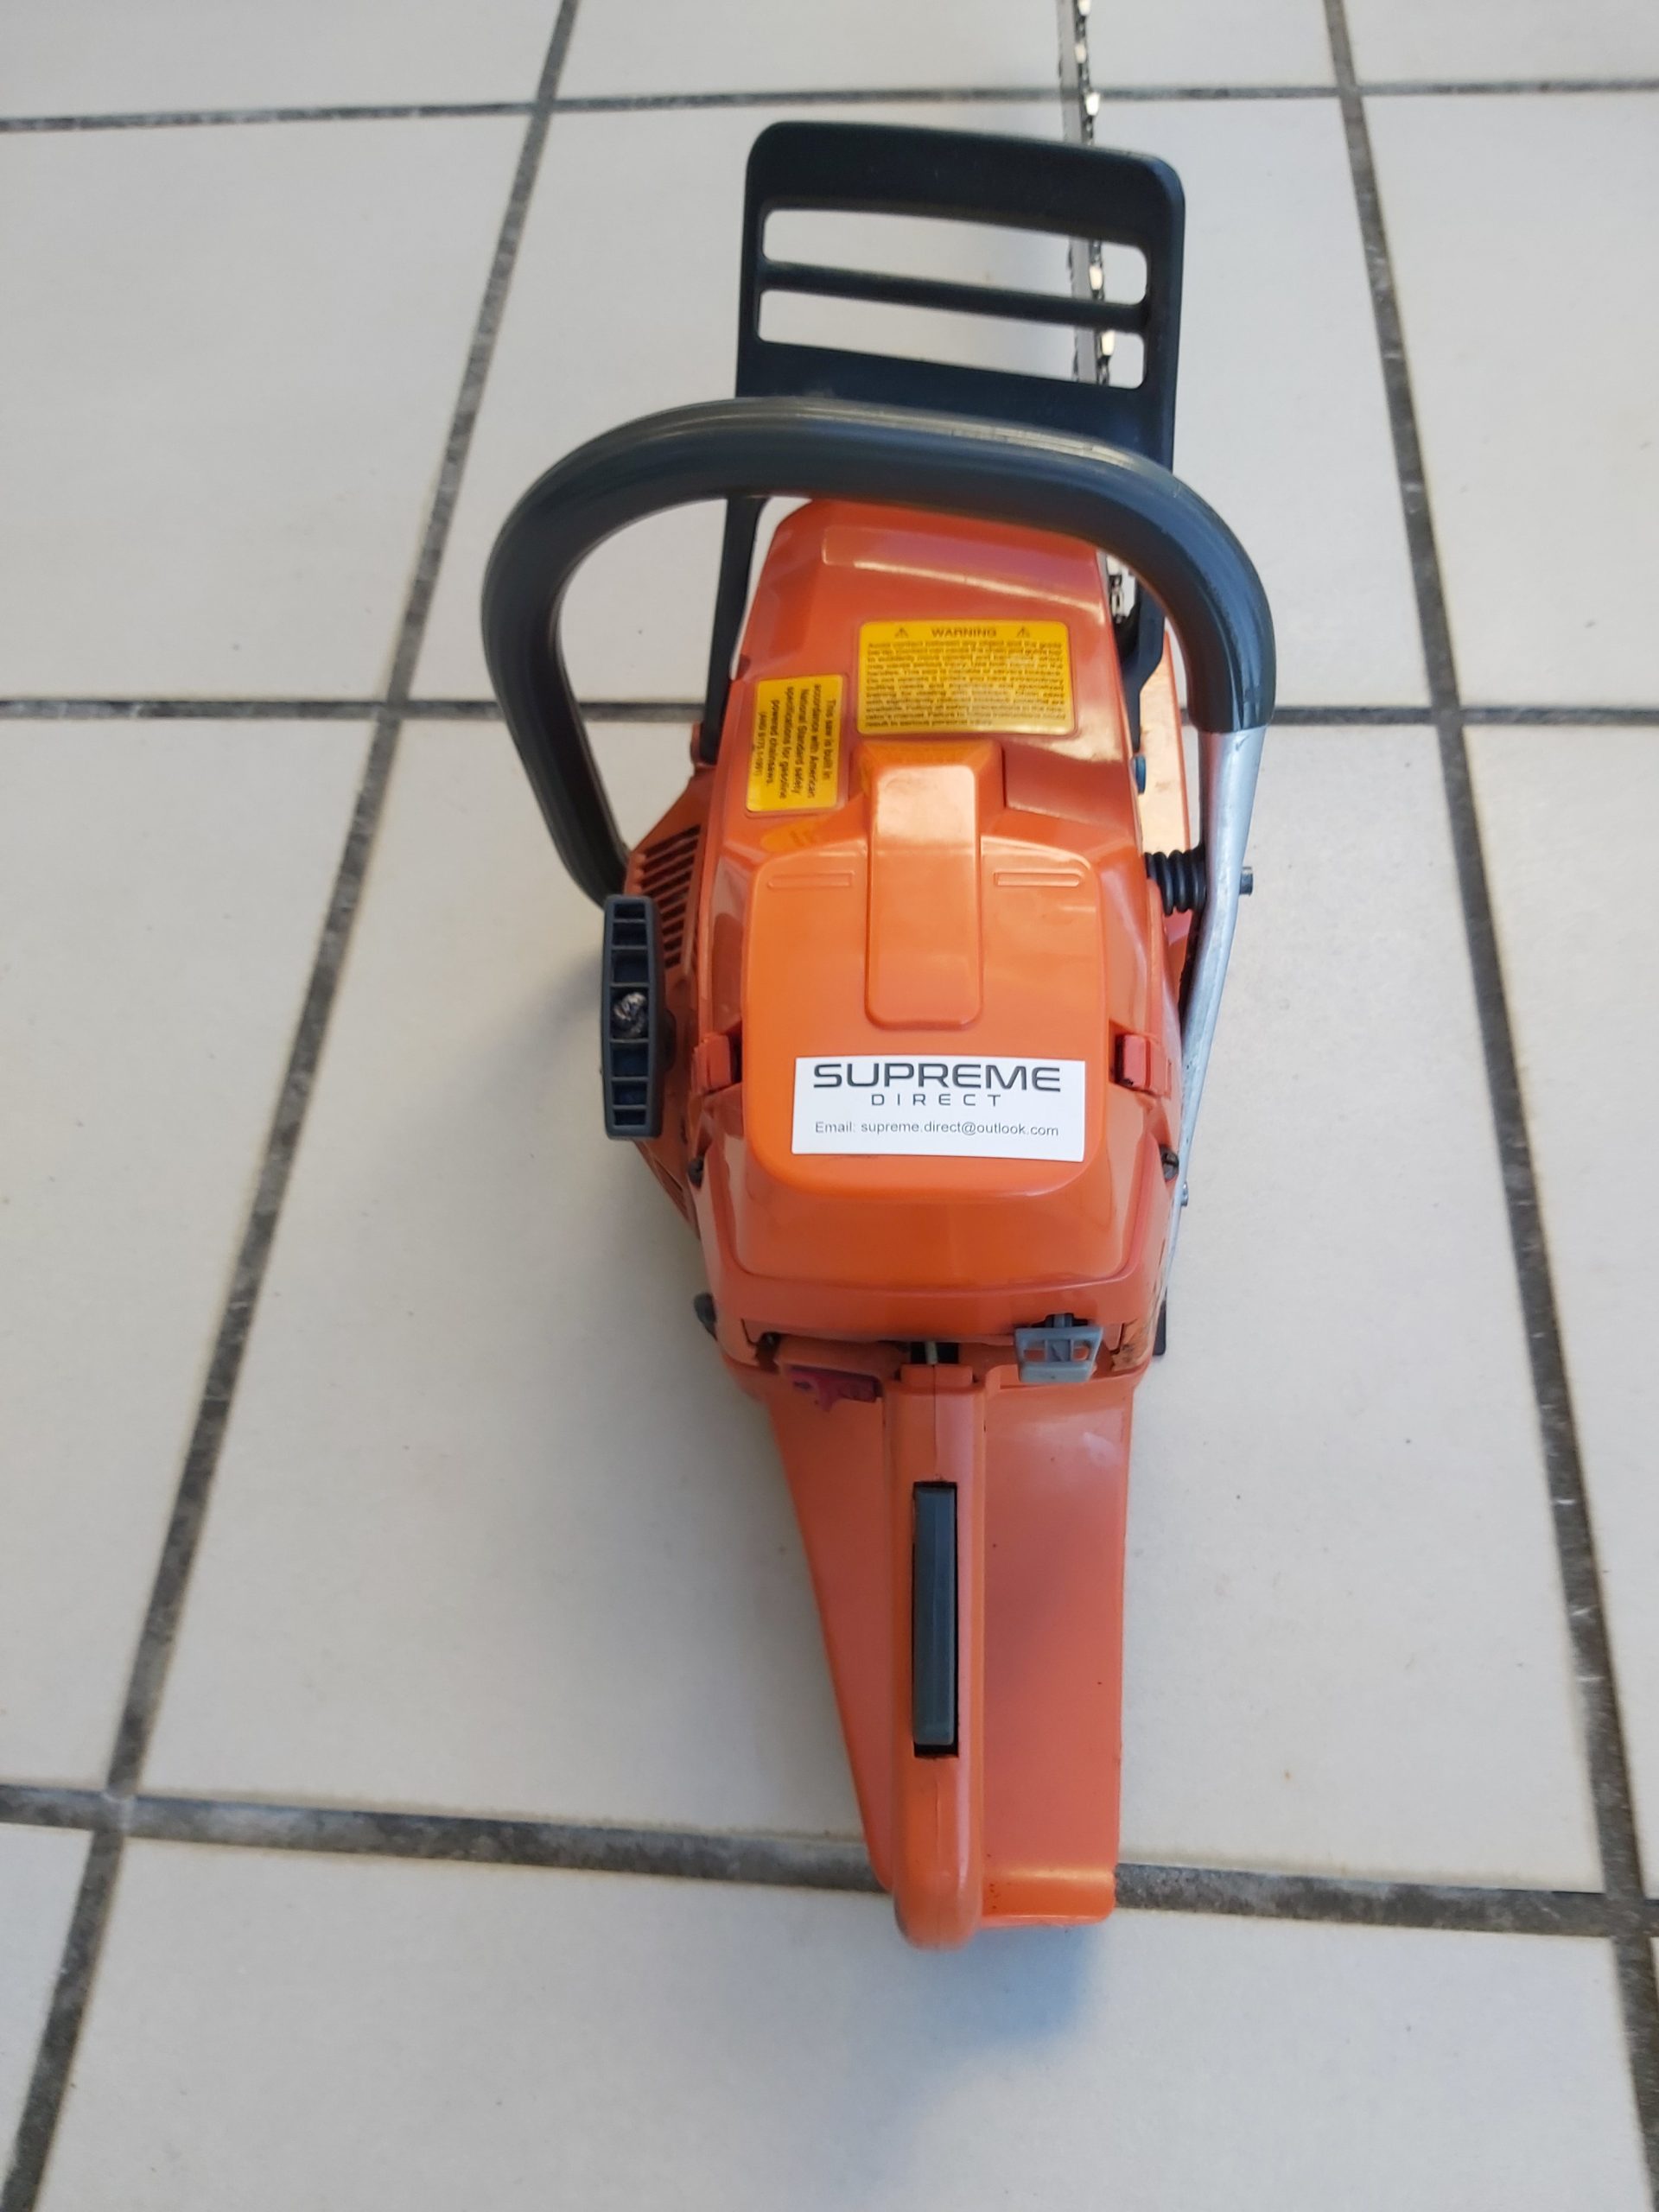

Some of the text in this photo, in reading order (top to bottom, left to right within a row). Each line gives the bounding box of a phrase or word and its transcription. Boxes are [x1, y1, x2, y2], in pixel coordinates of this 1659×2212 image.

[931, 627, 997, 638] WARNING
[770, 699, 780, 735] powered
[783, 686, 795, 745] specifications
[826, 699, 836, 718] This
[791, 689, 810, 794] National Standard safety
[807, 684, 822, 798] accordance with American
[824, 739, 834, 747] is
[781, 746, 791, 760] for
[823, 748, 834, 769] built
[823, 770, 832, 780] in
[813, 1063, 1061, 1093] SUPREME
[871, 1093, 1001, 1107] DIRECT
[815, 1121, 1059, 1137] Email: supreme.direct@outlook.com
